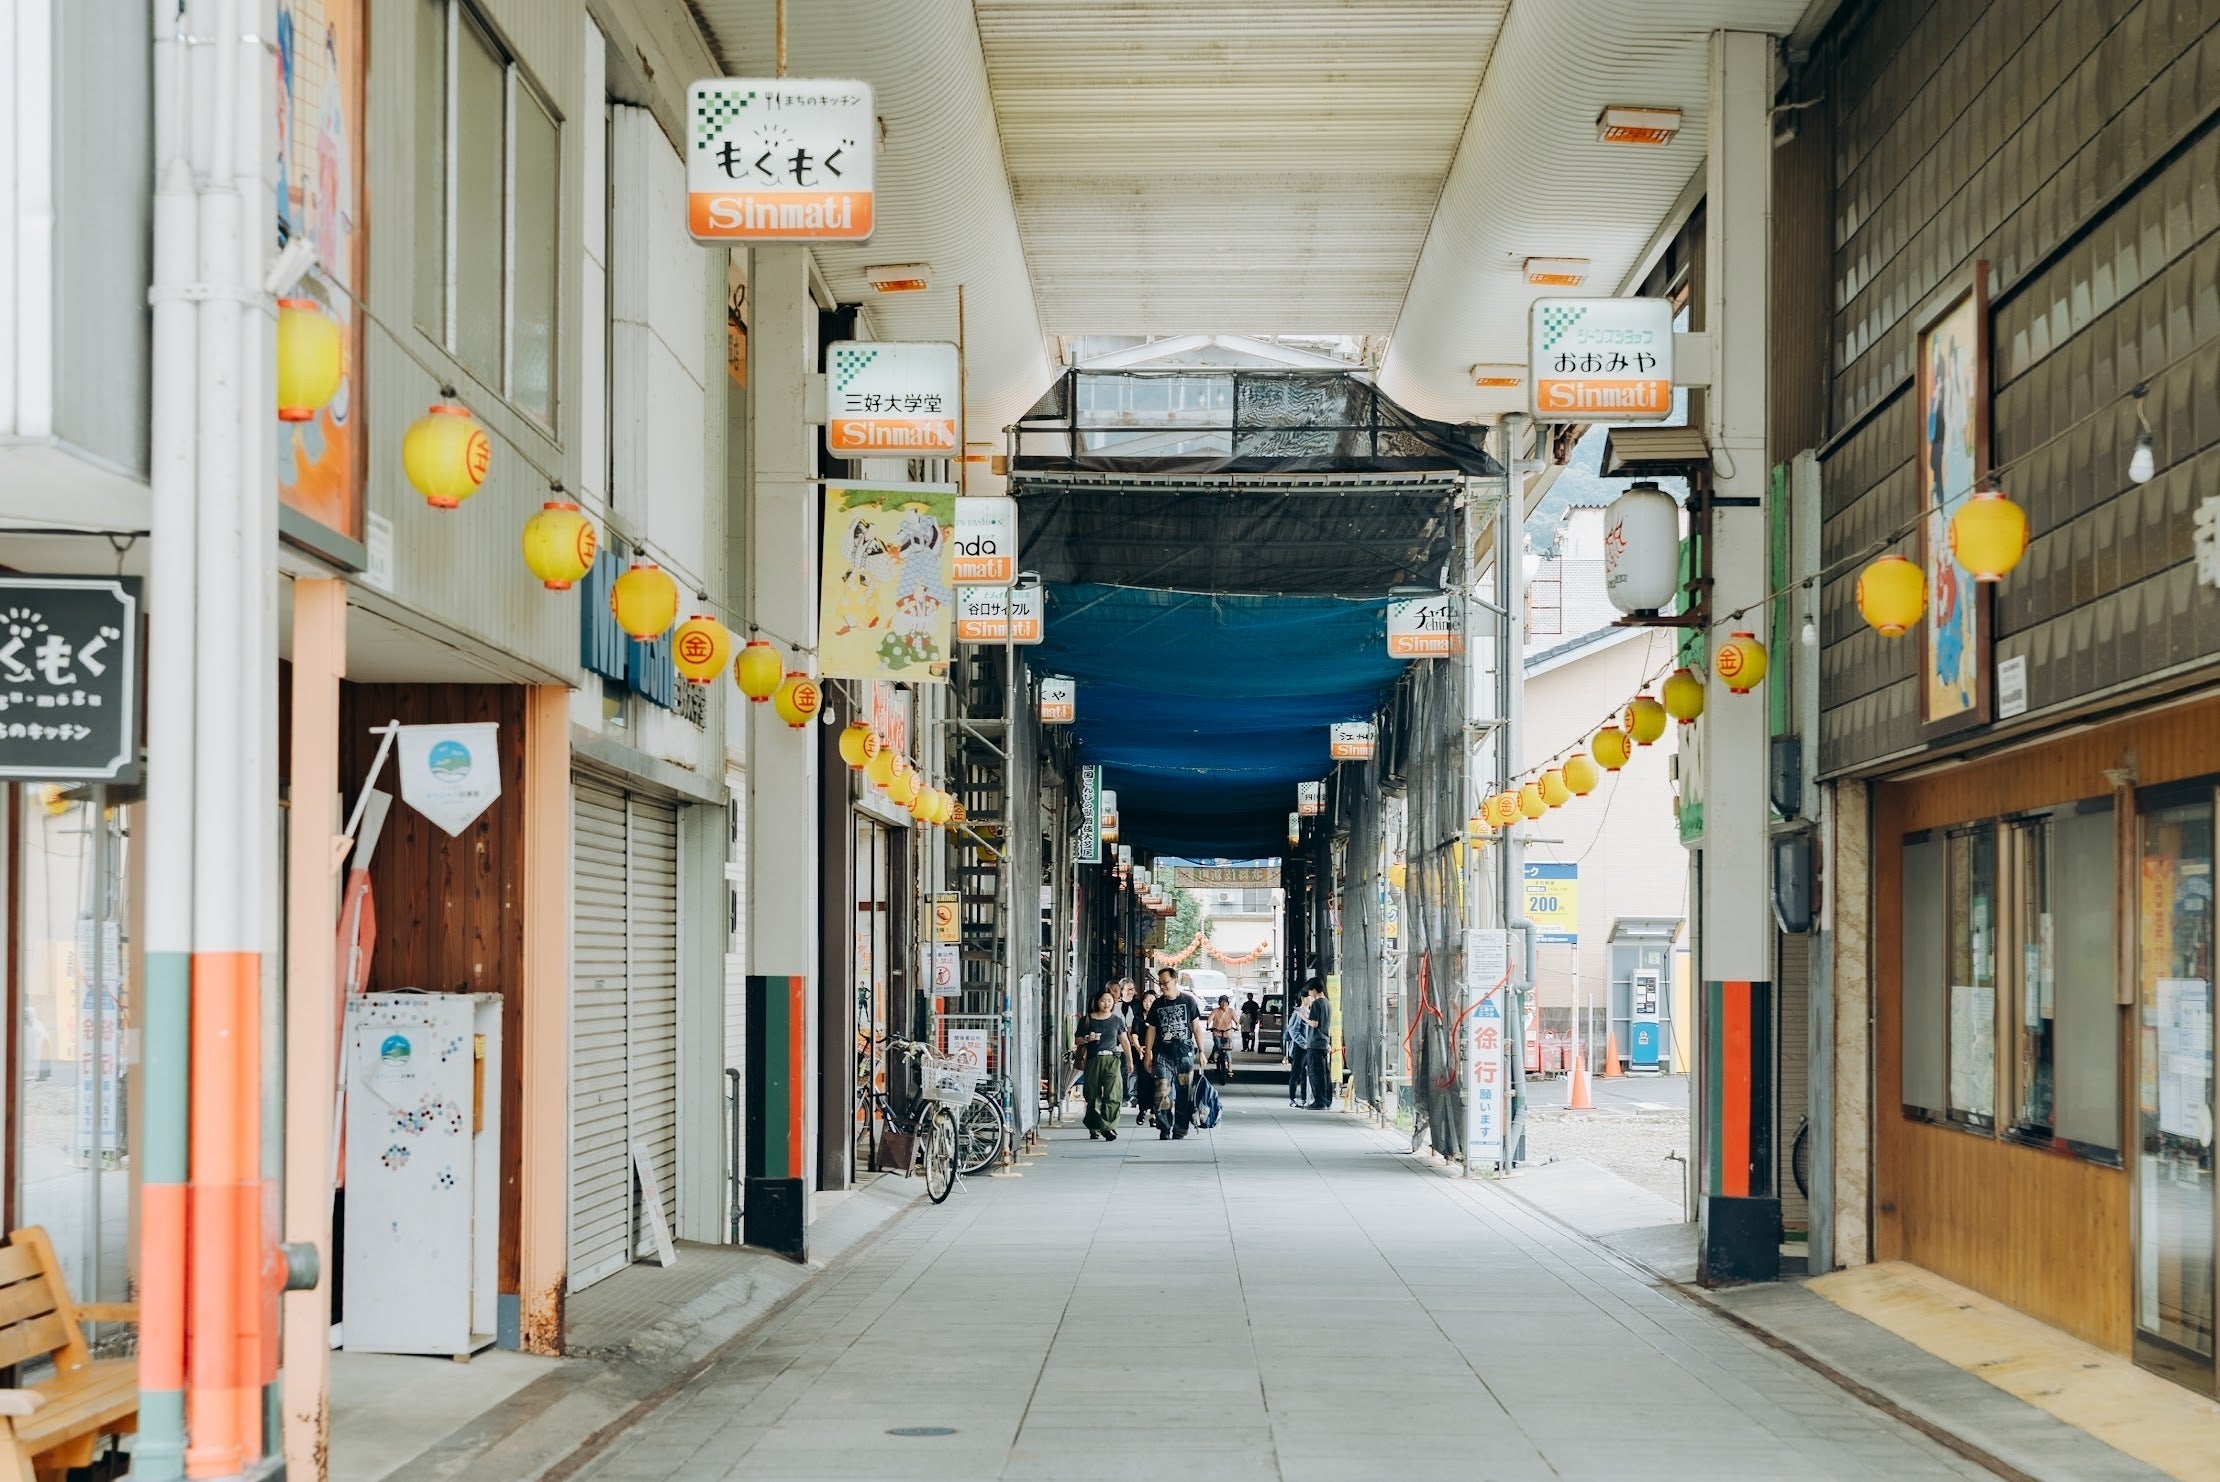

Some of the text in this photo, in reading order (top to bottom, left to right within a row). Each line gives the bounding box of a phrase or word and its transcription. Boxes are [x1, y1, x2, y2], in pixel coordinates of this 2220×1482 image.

[785, 95, 861, 106] まちのキッチン
[716, 138, 855, 187] もぐもぐ
[709, 195, 853, 230] Sinmati
[1554, 352, 1656, 373] おおみや
[845, 393, 942, 413] 三好大学堂
[1550, 381, 1657, 408] Sinmati
[842, 421, 946, 446] Sinmati
[686, 636, 707, 657] 金
[1719, 648, 1737, 670] 金
[798, 687, 815, 707] 金
[926, 893, 958, 902] WRNING!
[1474, 1026, 1498, 1084] 徐行
[1479, 1088, 1492, 1138] 願います
